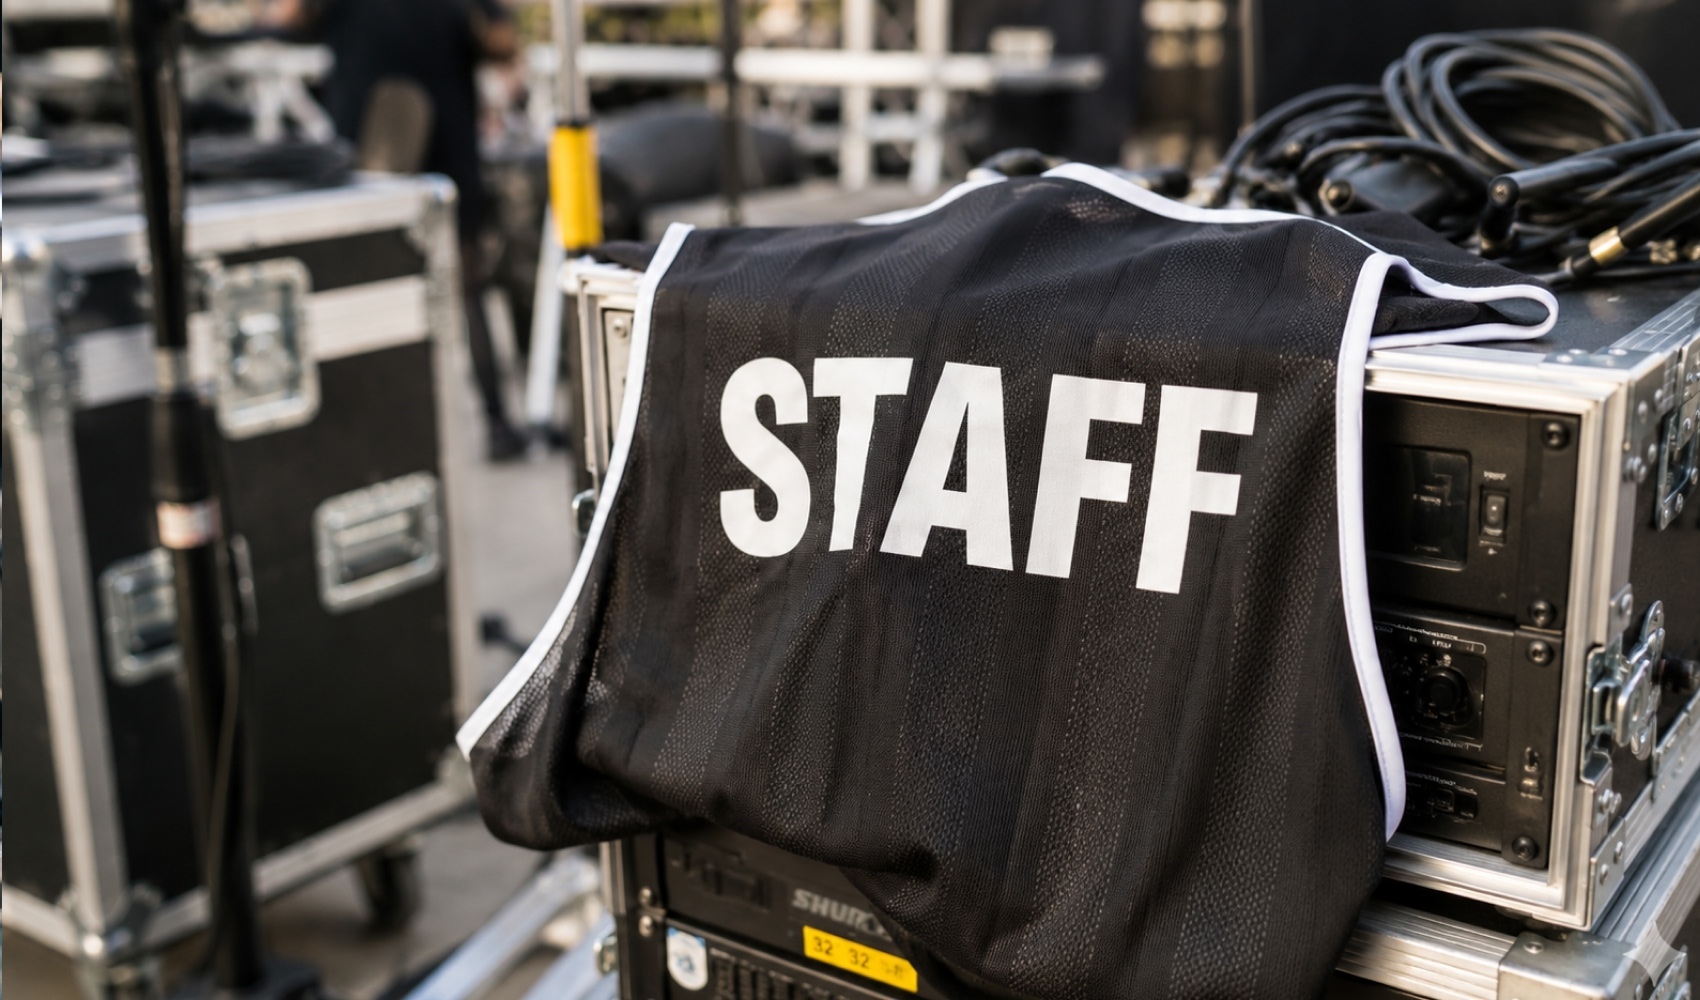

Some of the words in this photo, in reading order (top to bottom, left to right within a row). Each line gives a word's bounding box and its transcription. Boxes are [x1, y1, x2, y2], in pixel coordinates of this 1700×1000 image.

[720, 357, 1258, 594] STAFF
[813, 936, 833, 956] 32
[848, 948, 870, 969] 32
